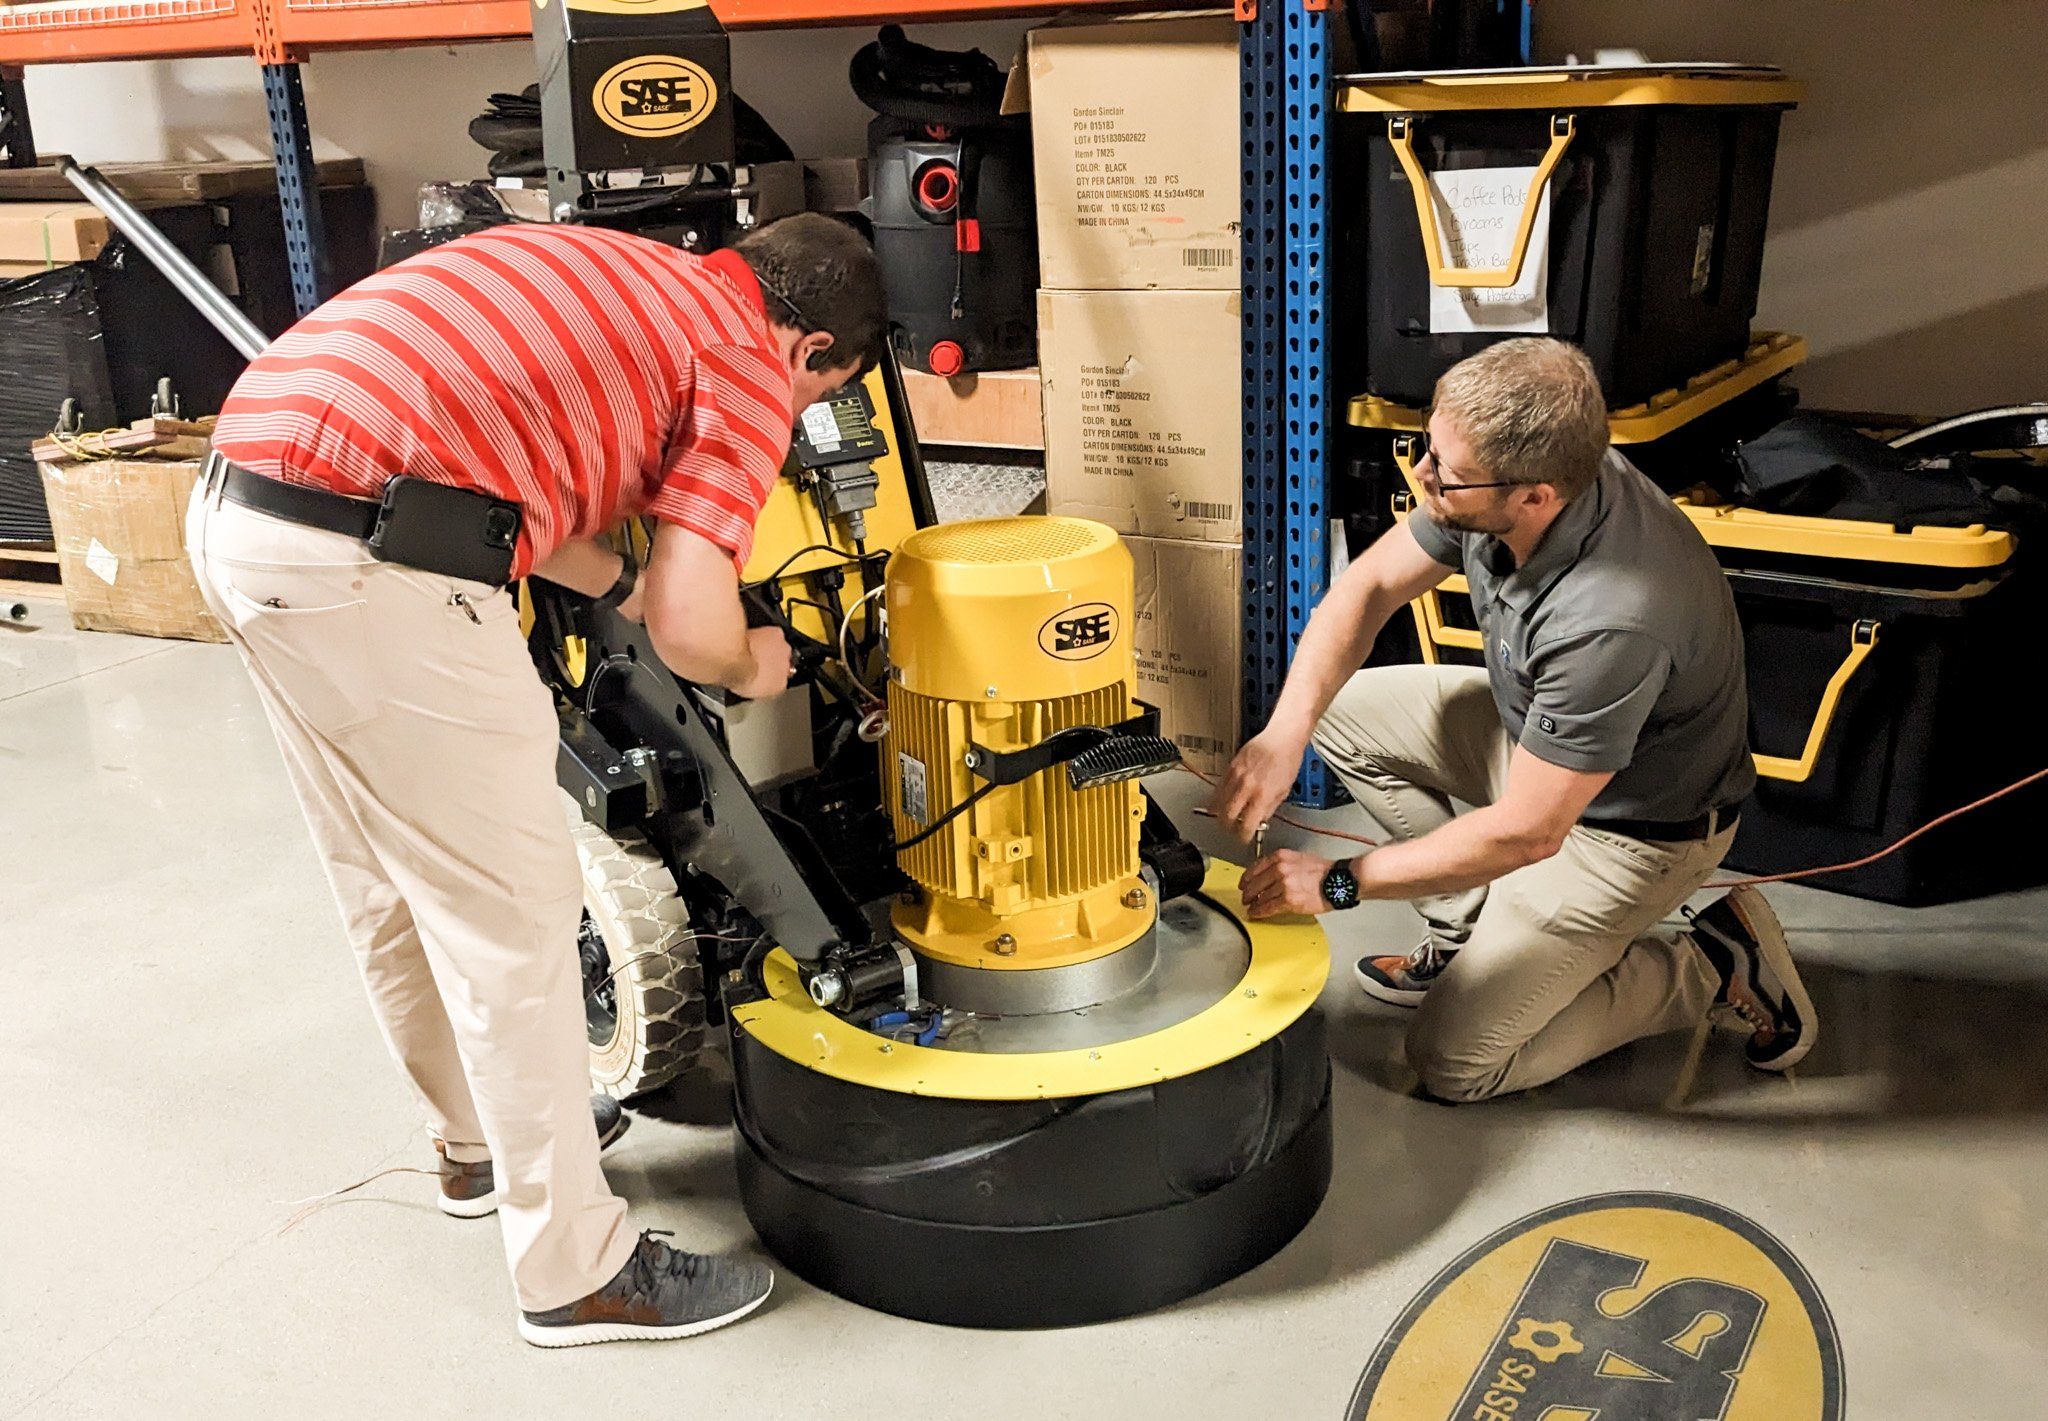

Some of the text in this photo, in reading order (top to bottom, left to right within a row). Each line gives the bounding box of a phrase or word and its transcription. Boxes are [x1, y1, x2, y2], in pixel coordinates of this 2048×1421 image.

[620, 77, 692, 116] SASE
[1073, 106, 1124, 117] Gordon Sinclair
[1090, 120, 1115, 130] 015183
[1096, 148, 1115, 158] TM25
[1105, 162, 1127, 173] BLACK
[1091, 176, 1105, 186] PER
[1144, 175, 1157, 185] 120
[1165, 174, 1179, 184] PCS
[1077, 190, 1104, 200] CARTON
[1111, 203, 1120, 212] 10
[1151, 202, 1166, 213] KGS
[1078, 216, 1130, 227] MADE IN CHINA
[1080, 364, 1103, 374] Gordon
[1096, 378, 1121, 388] 015183
[1102, 403, 1121, 413] TM25
[1110, 418, 1132, 427] BLACK
[1097, 429, 1111, 438] PER
[1148, 432, 1161, 441] 120
[1167, 432, 1182, 442] PCS
[1083, 441, 1110, 451] CARTON
[1116, 455, 1124, 464] 10
[1154, 457, 1169, 467] KGS
[1084, 466, 1134, 477] MADE IN CHINA
[1055, 611, 1110, 652] SASE
